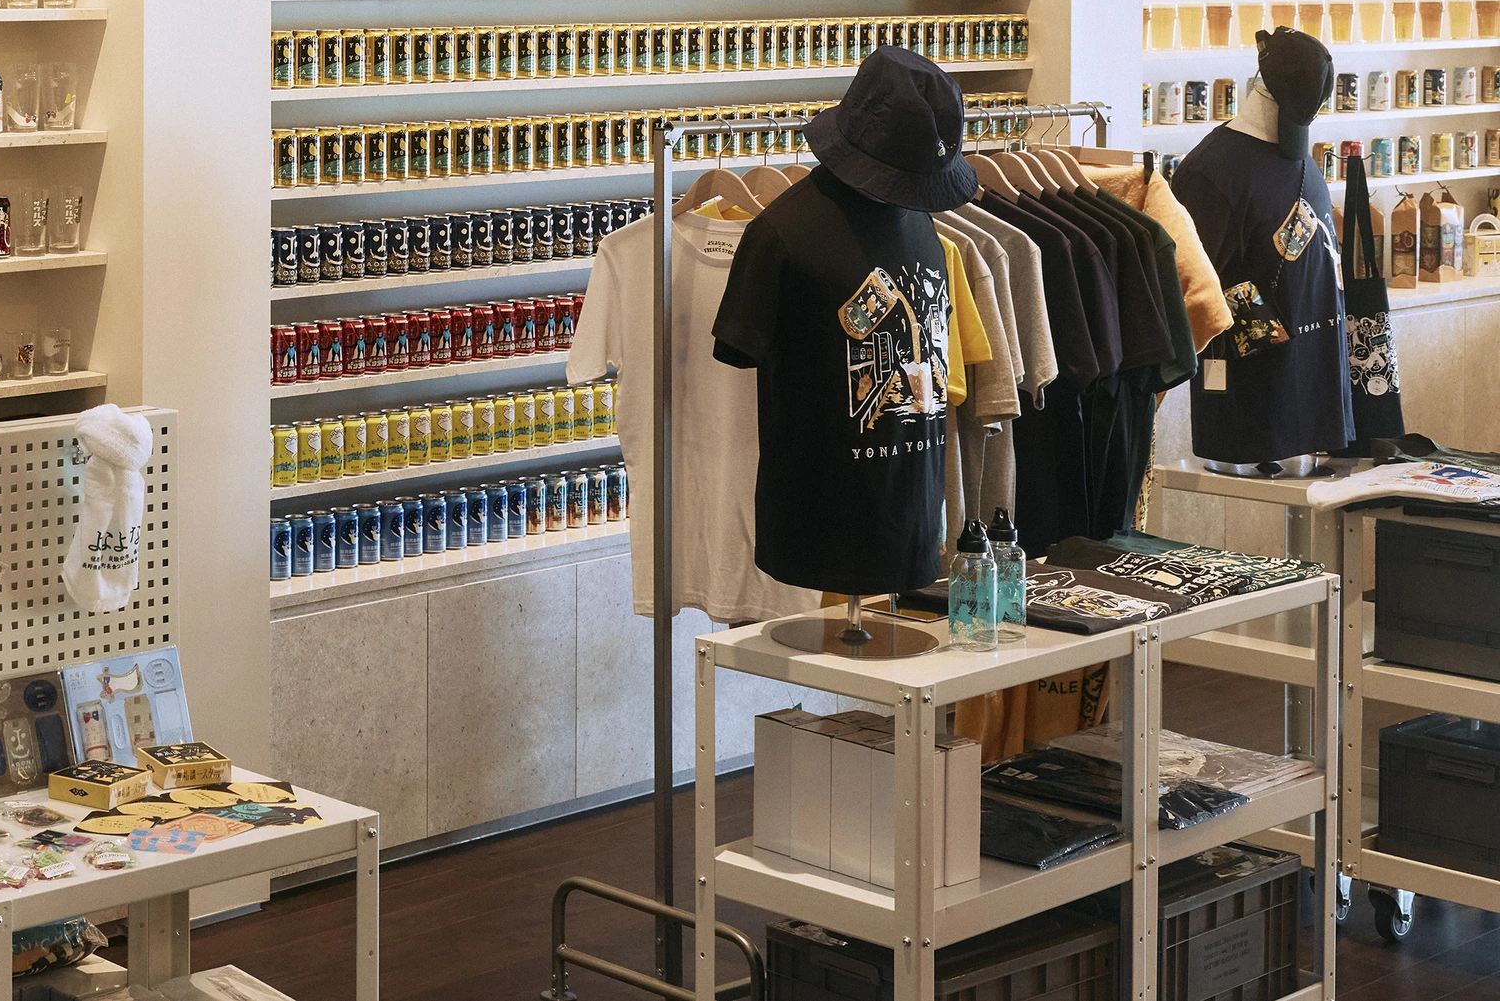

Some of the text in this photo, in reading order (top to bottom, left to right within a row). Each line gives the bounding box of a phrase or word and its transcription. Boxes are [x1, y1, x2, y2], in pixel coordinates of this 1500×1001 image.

[1298, 322, 1321, 334] YONA
[852, 446, 898, 460] YONA
[1038, 679, 1078, 694] PALE
